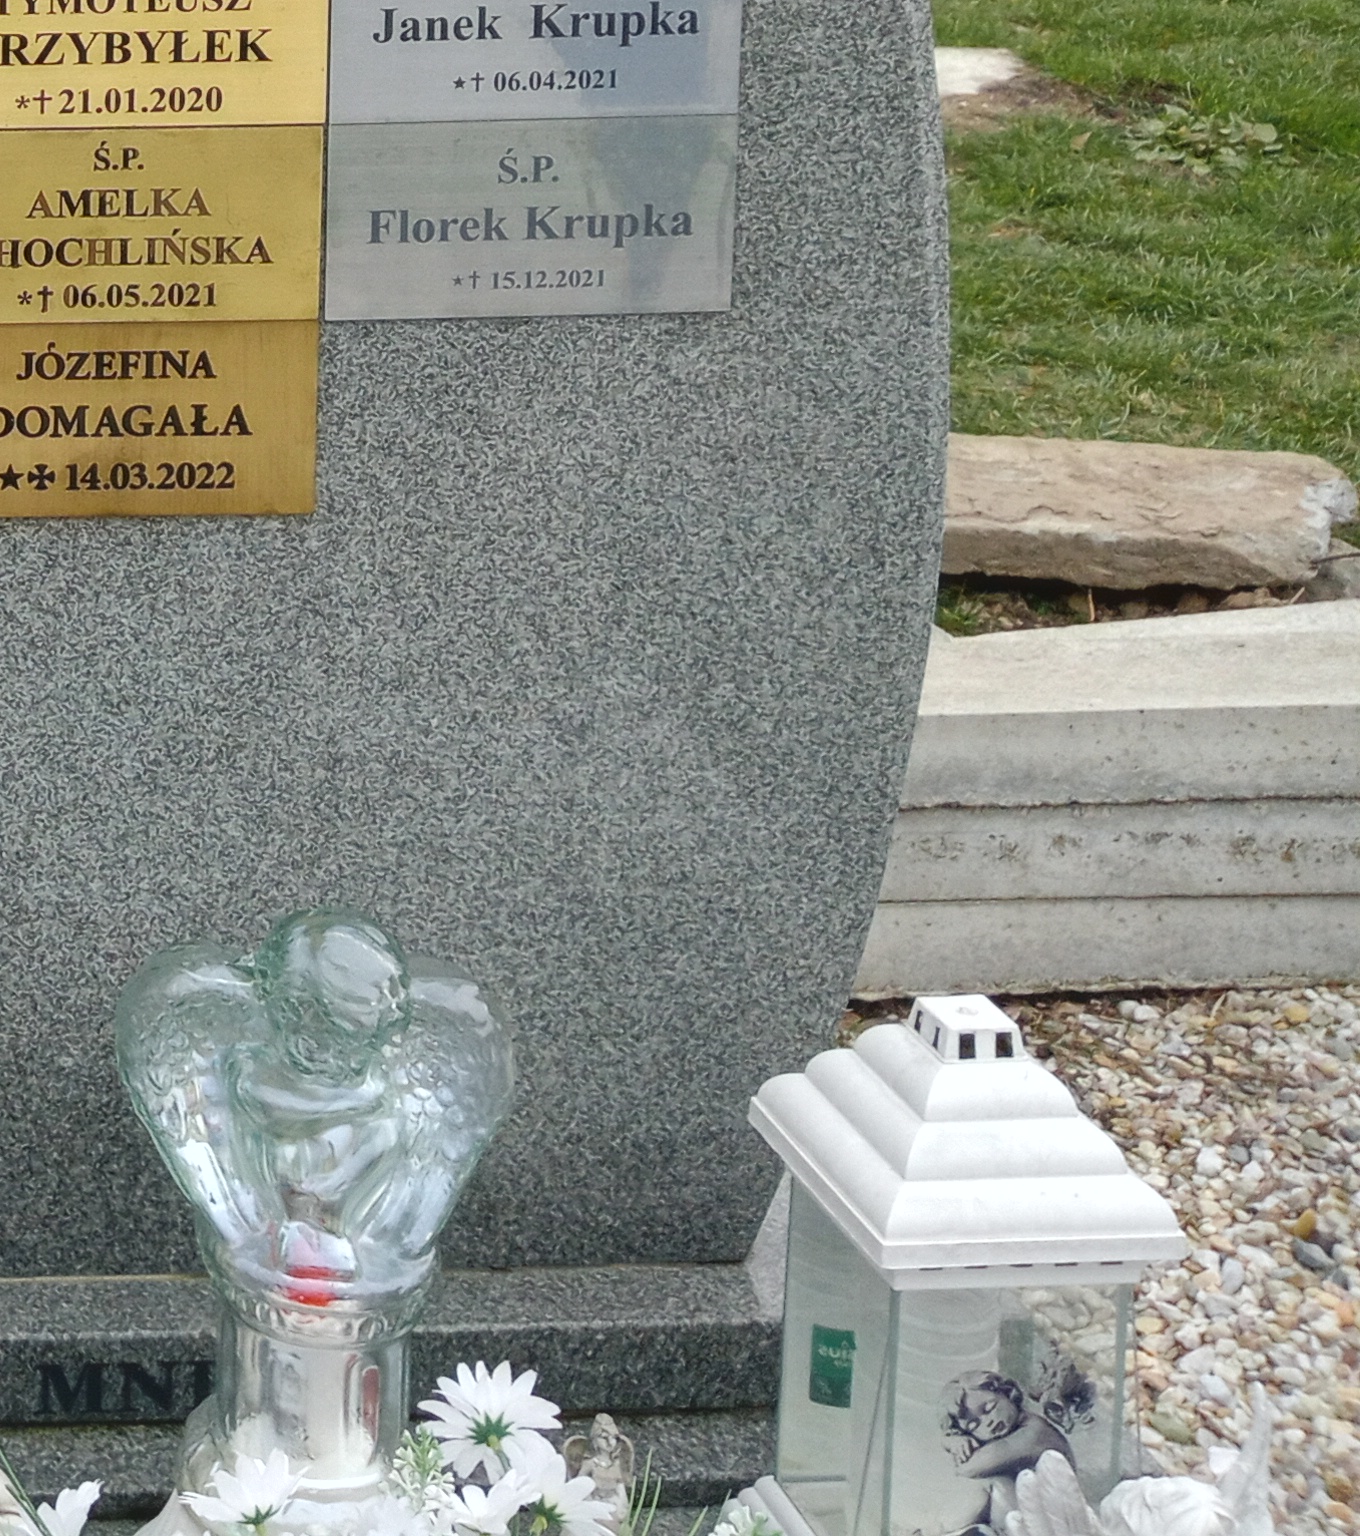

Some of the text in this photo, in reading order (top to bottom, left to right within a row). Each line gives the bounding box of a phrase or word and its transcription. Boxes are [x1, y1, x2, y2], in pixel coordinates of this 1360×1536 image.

[372, 1, 700, 48] Janek Krupka
[93, 140, 144, 172] Ś.P.
[497, 147, 559, 185] Ś.P.
[25, 187, 212, 219] AMELKA
[368, 203, 694, 249] Florek Krupka
[15, 341, 217, 381] JÓZEFINA
[33, 1361, 217, 1416] MNI
